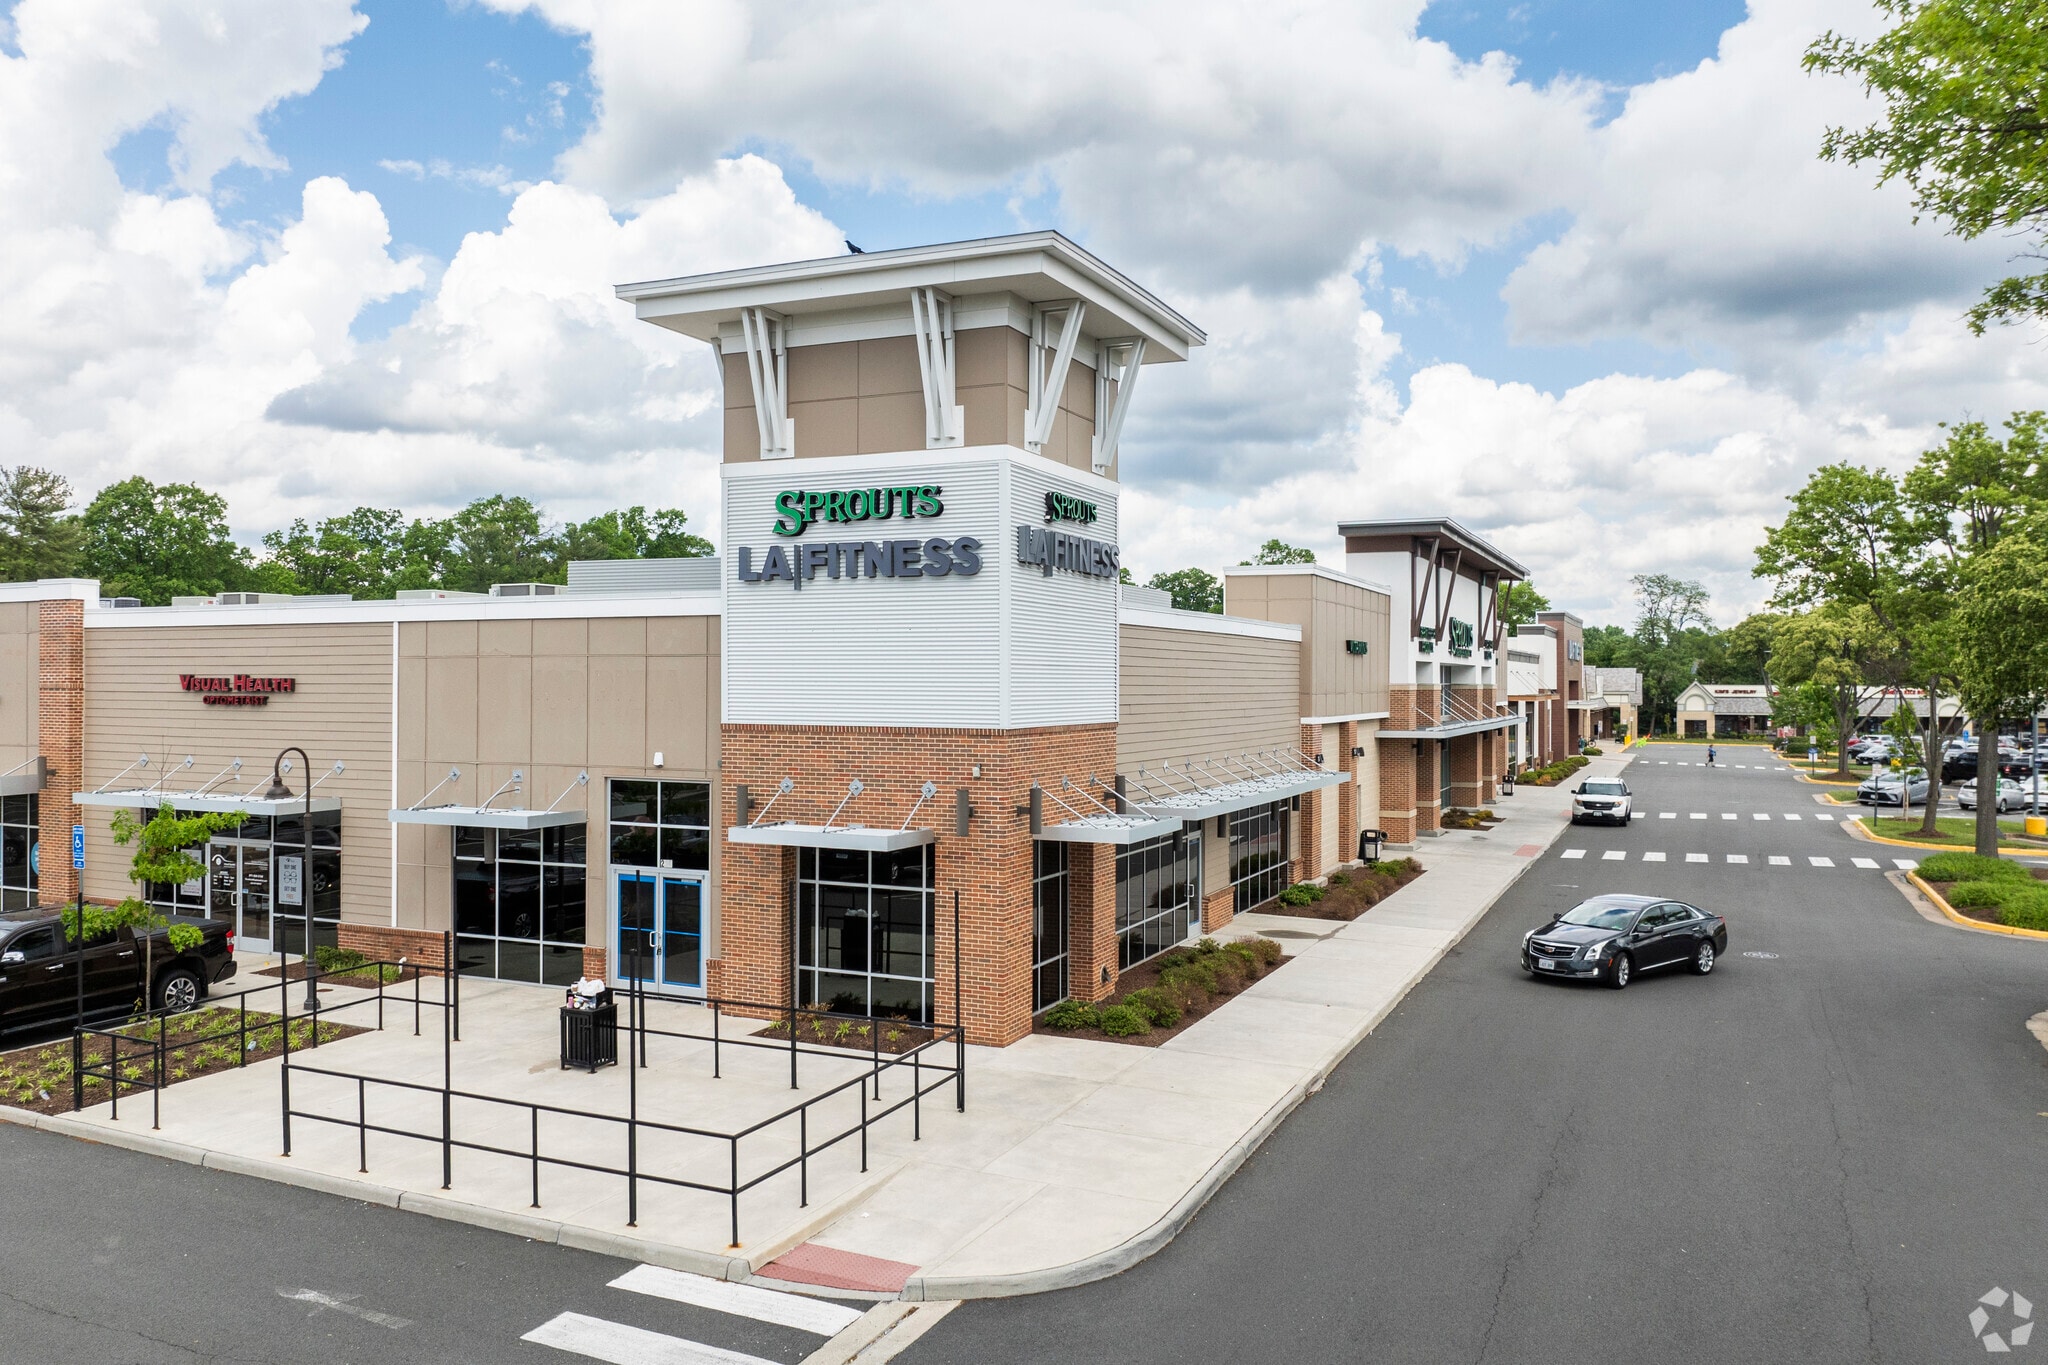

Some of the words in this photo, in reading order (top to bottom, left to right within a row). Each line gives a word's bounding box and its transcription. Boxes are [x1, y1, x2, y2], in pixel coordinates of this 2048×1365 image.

[772, 485, 943, 536] SPROUTS
[179, 674, 231, 692] VISUAL
[234, 674, 295, 693] HEALTH
[203, 695, 268, 706] OPTOMETRIST
